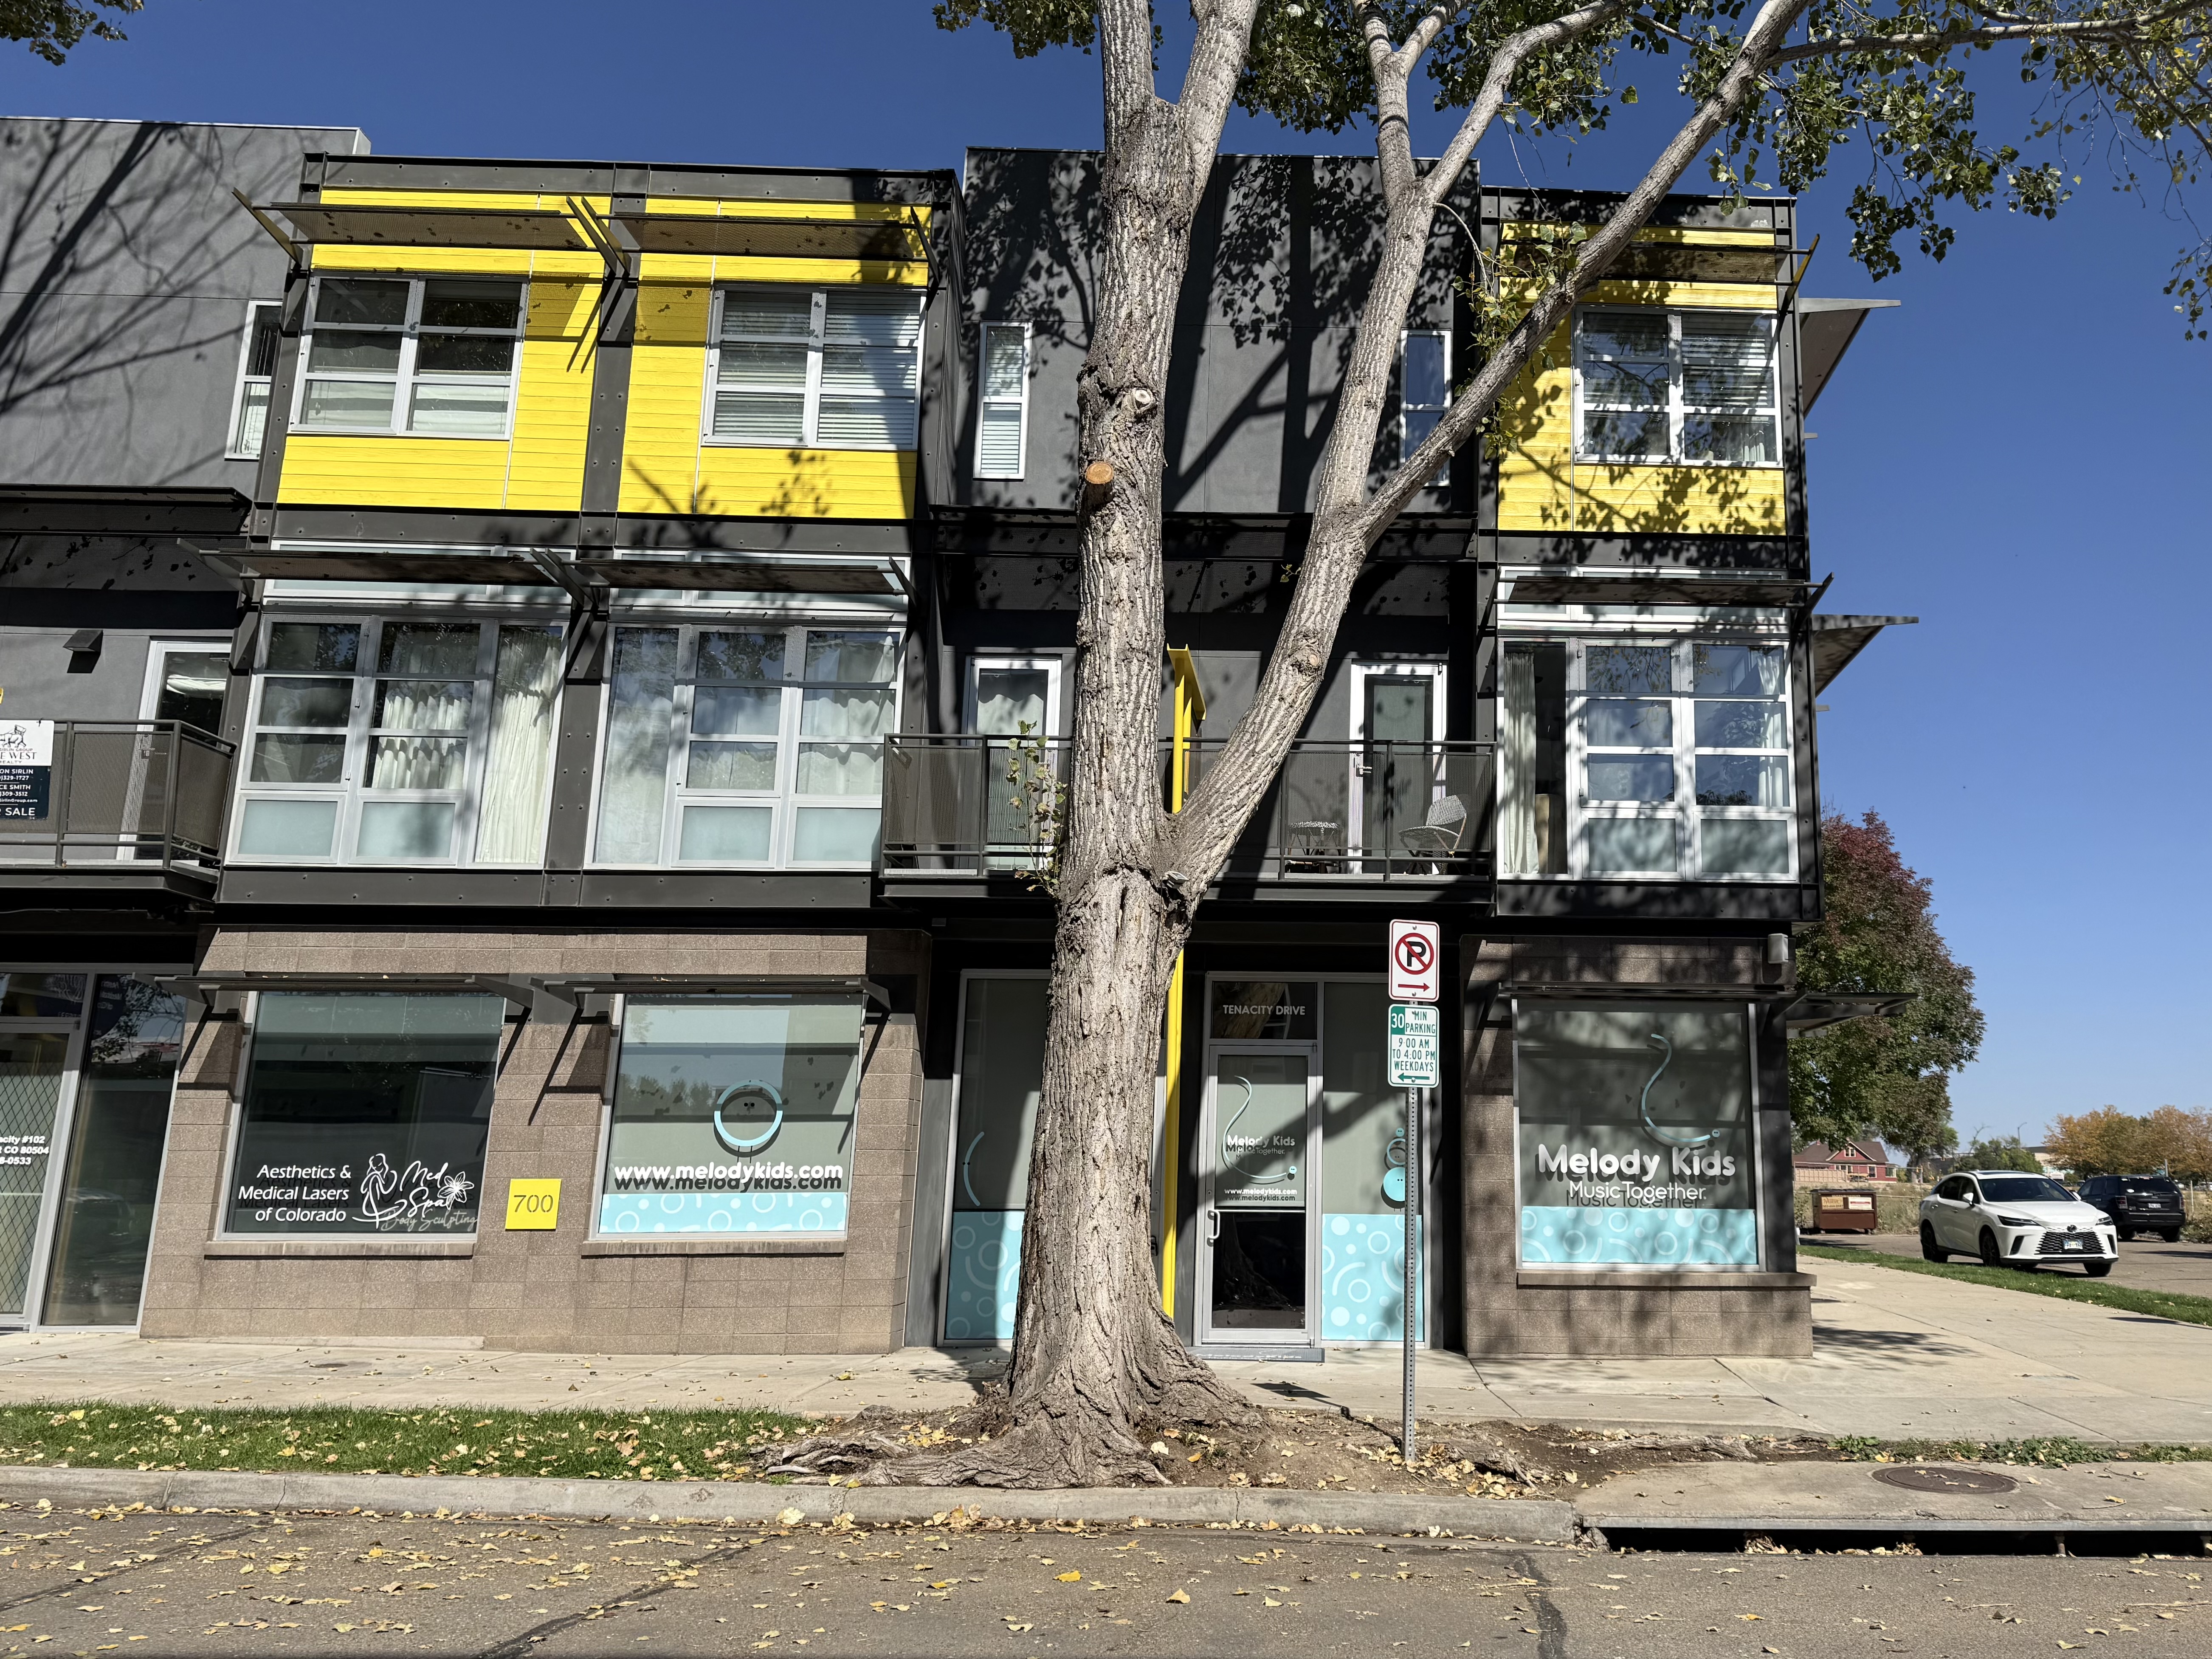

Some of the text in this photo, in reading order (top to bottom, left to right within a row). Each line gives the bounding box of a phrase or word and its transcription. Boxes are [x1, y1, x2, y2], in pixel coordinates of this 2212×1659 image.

[5, 807, 35, 816] SALE
[1223, 1005, 1305, 1015] TENACITY DRIVE
[1415, 1011, 1427, 1021] MIN
[1391, 1013, 1405, 1028] 30
[1406, 1023, 1435, 1033] PARKING
[1419, 1039, 1429, 1049] AM
[1392, 1049, 1435, 1061] TO 4:00 PM
[1394, 1061, 1434, 1072] WEEKDAYS
[22, 1135, 45, 1143] #102
[1227, 1134, 1295, 1148] Melody Kids
[20, 1146, 49, 1154] 80504
[1538, 1143, 1736, 1182] Melody Kids
[256, 1165, 351, 1179] Aesthetics &
[400, 1160, 448, 1191] Med
[614, 1162, 843, 1184] www.melodykids.com
[238, 1186, 349, 1200] Medical Lasers
[407, 1187, 447, 1218] Spa
[514, 1195, 553, 1213] 700
[255, 1207, 346, 1222] of Colorado
[418, 1209, 478, 1232] Sculpting
